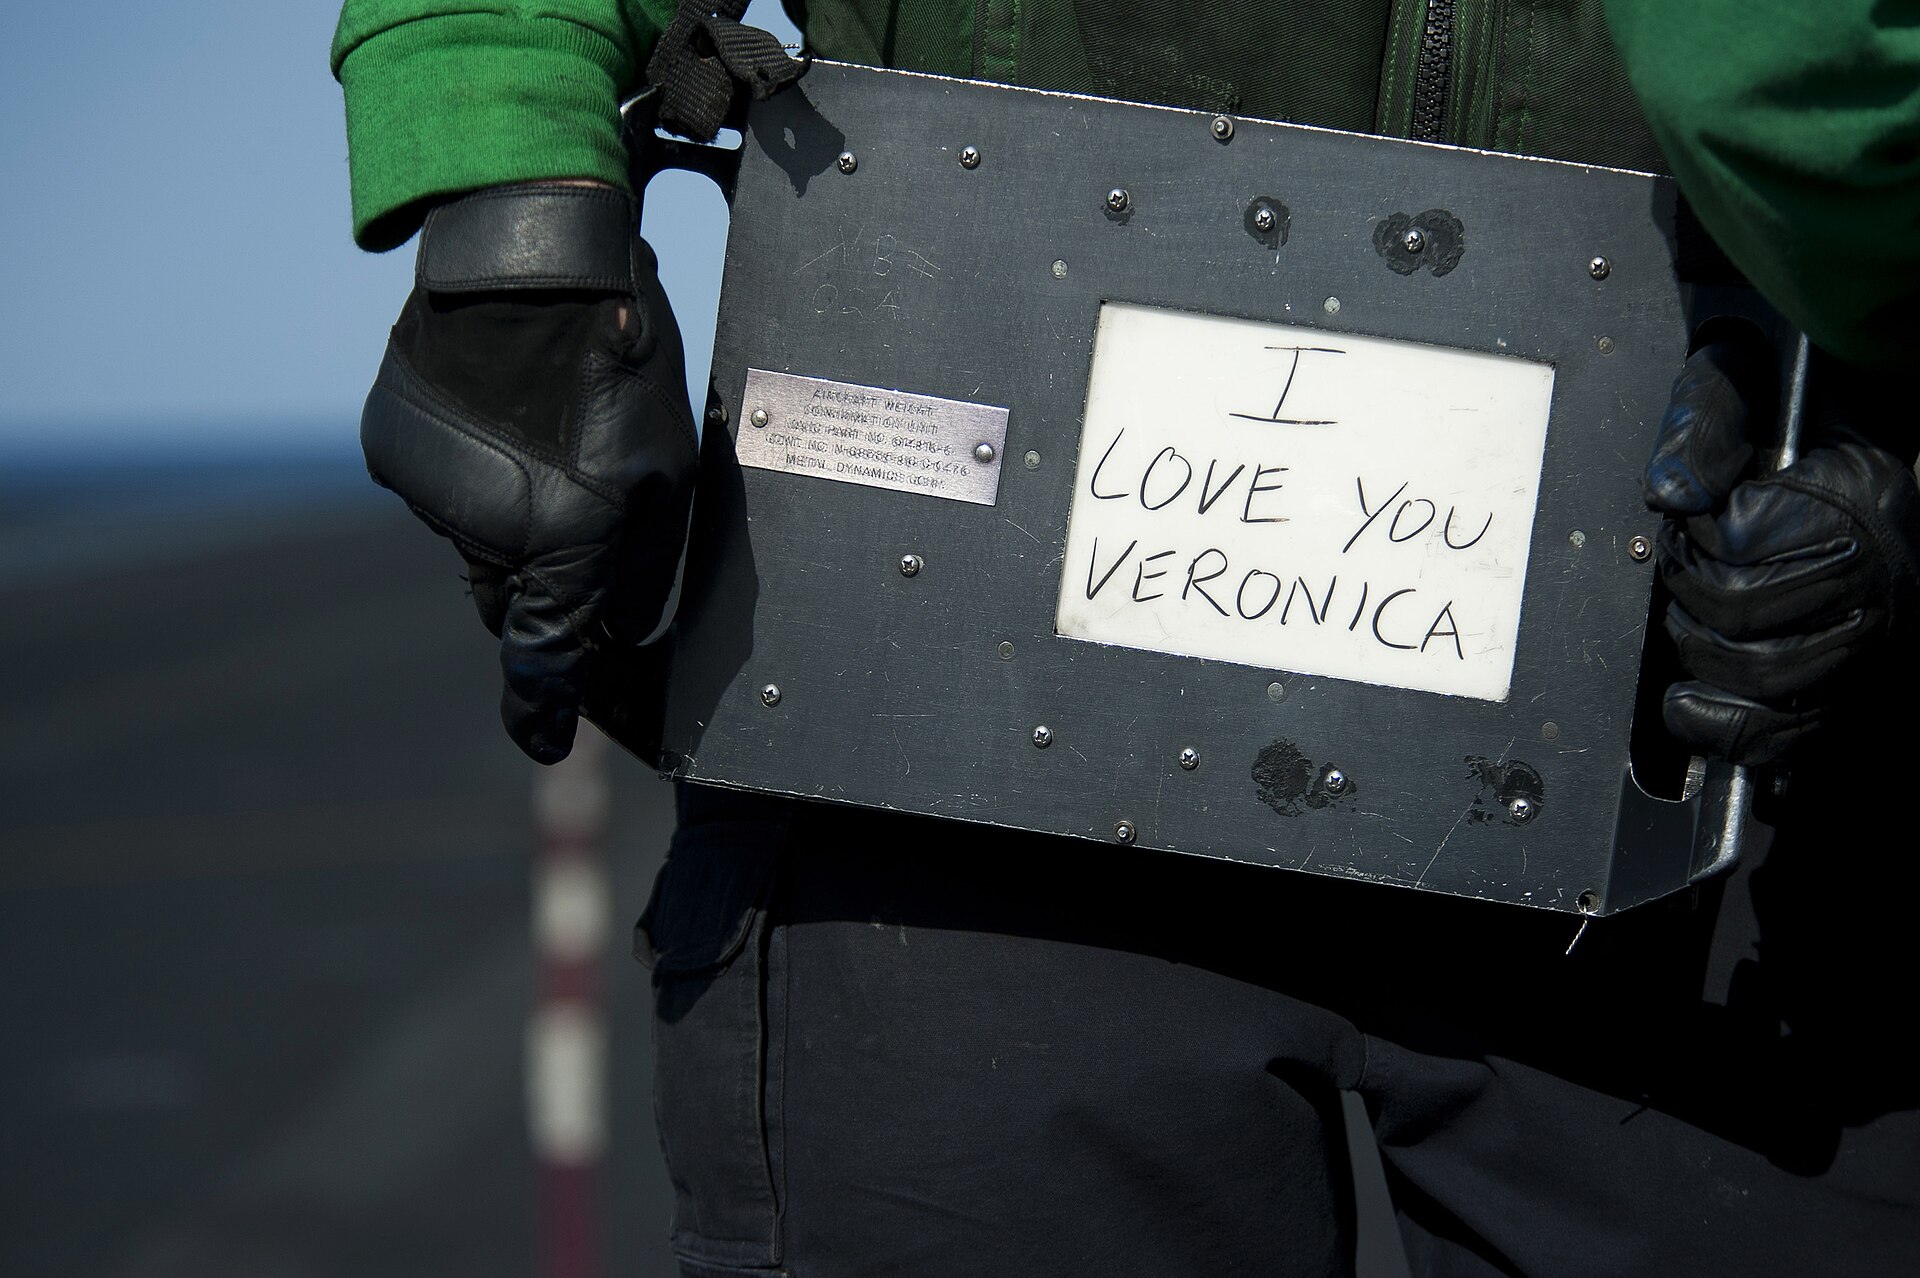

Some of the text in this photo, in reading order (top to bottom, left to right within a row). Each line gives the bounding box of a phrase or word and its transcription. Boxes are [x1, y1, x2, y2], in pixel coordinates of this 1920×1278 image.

[813, 389, 936, 416] AIRCRAFT WEIGHT
[1229, 346, 1346, 425] I
[786, 453, 831, 471] METAL
[836, 461, 905, 484] DYNAMICS
[1091, 428, 1493, 553] LOVE YOU
[1086, 537, 1464, 660] VERONICA
